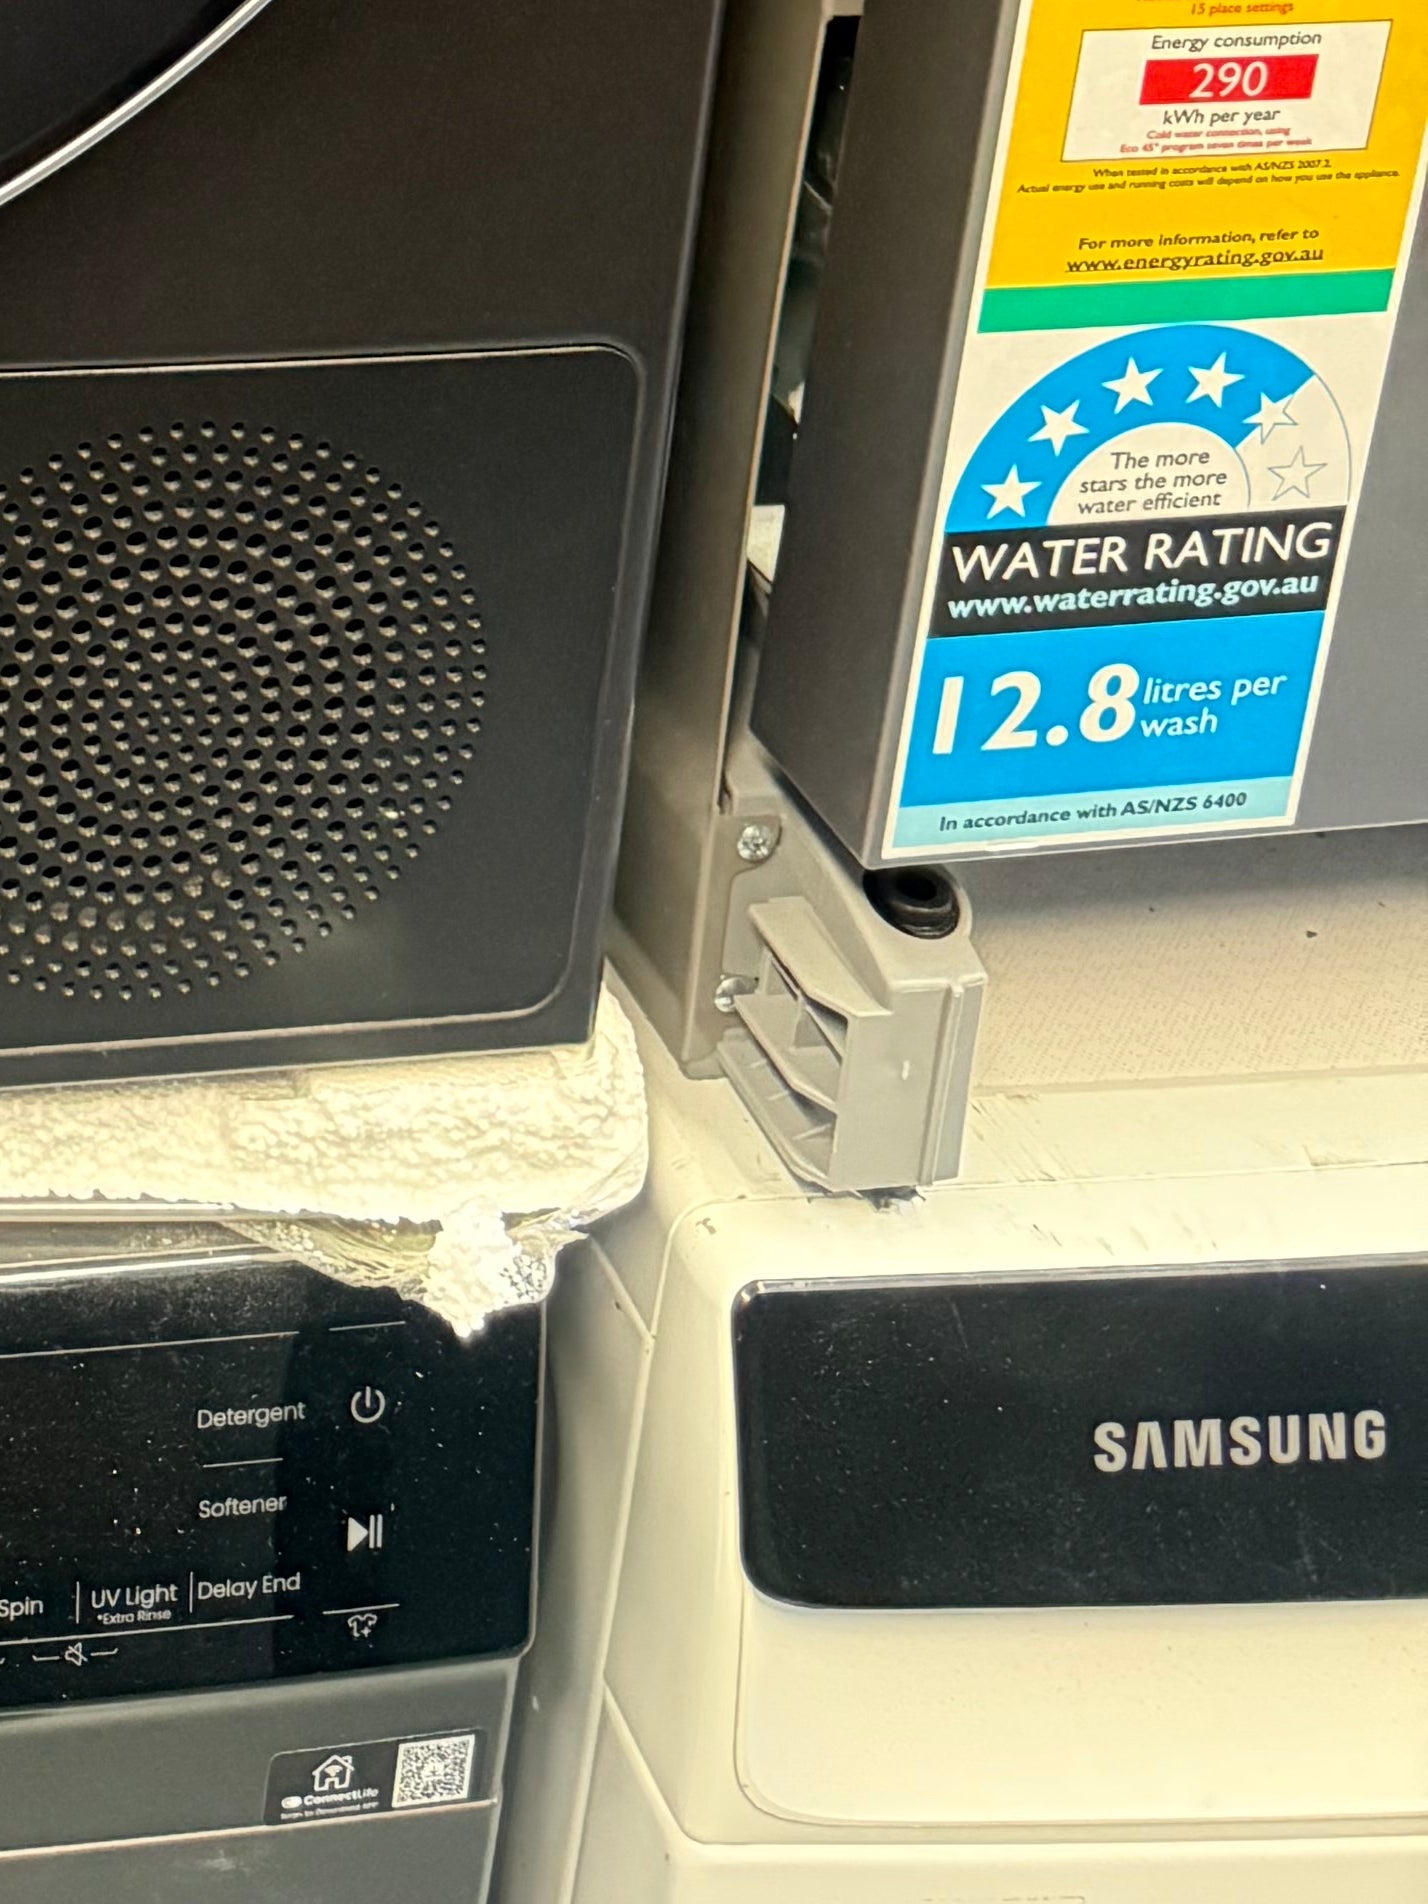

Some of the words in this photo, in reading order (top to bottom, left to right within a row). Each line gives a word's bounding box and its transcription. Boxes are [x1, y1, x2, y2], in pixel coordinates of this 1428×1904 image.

[1151, 34, 1208, 53] Energy
[1213, 31, 1322, 51] consumption
[1188, 61, 1268, 99] 290
[1162, 109, 1204, 125] kWh
[1210, 111, 1237, 128] per
[1243, 108, 1280, 124] year
[1079, 236, 1107, 250] For
[1110, 235, 1153, 248] more
[1259, 229, 1297, 243] refer
[1302, 228, 1319, 240] to
[1065, 246, 1323, 273] www.energyrating.gov.au
[1111, 452, 1150, 469] The
[1156, 449, 1210, 467] more
[1079, 473, 1128, 494] stars
[1133, 472, 1167, 490] the
[1172, 470, 1227, 487] more
[1078, 496, 1137, 515] water
[1142, 491, 1221, 511] efficient
[952, 536, 1128, 583] WATER
[1144, 520, 1334, 571] RATING
[947, 574, 1318, 619] www.waterrating.gov.au
[1143, 677, 1222, 705] litres
[1231, 673, 1287, 706] per
[933, 662, 1140, 754] 12.8
[1140, 708, 1217, 739] wash
[940, 815, 957, 832] In
[962, 807, 1070, 828] accordance
[1076, 803, 1117, 820] with
[1121, 795, 1197, 818] AS/NZS
[1202, 792, 1247, 810] 6400
[197, 1401, 307, 1429] Detergent
[1093, 1409, 1386, 1473] SAMSUNG
[198, 1495, 287, 1519] Softener
[91, 1589, 120, 1609] UV
[125, 1584, 178, 1608] Light
[197, 1579, 258, 1601] Delay
[262, 1572, 301, 1594] End
